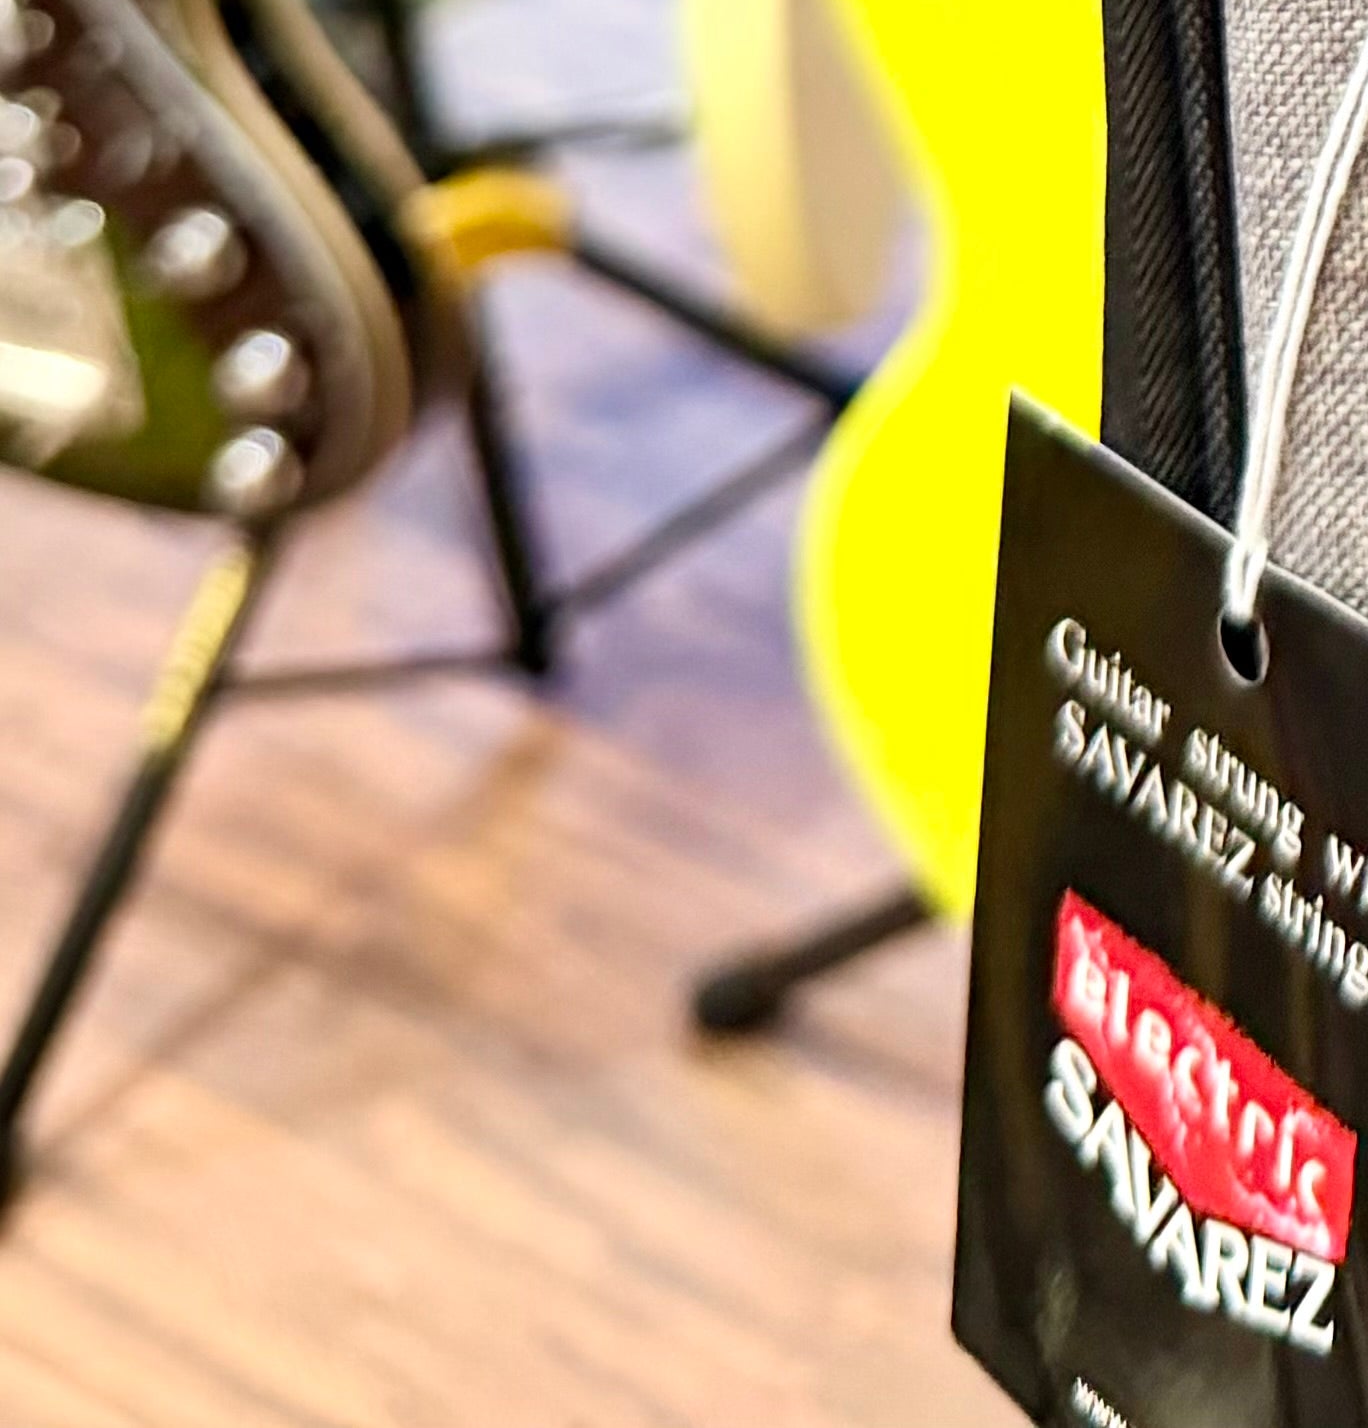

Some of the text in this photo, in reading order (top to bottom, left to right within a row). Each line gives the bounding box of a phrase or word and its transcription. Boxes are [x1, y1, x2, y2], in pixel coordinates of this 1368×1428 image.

[1047, 617, 1172, 747] Guitar
[1184, 727, 1305, 870] strung
[1055, 699, 1256, 903] SAVAREZ
[1044, 1037, 1337, 1356] SAVAREZ
